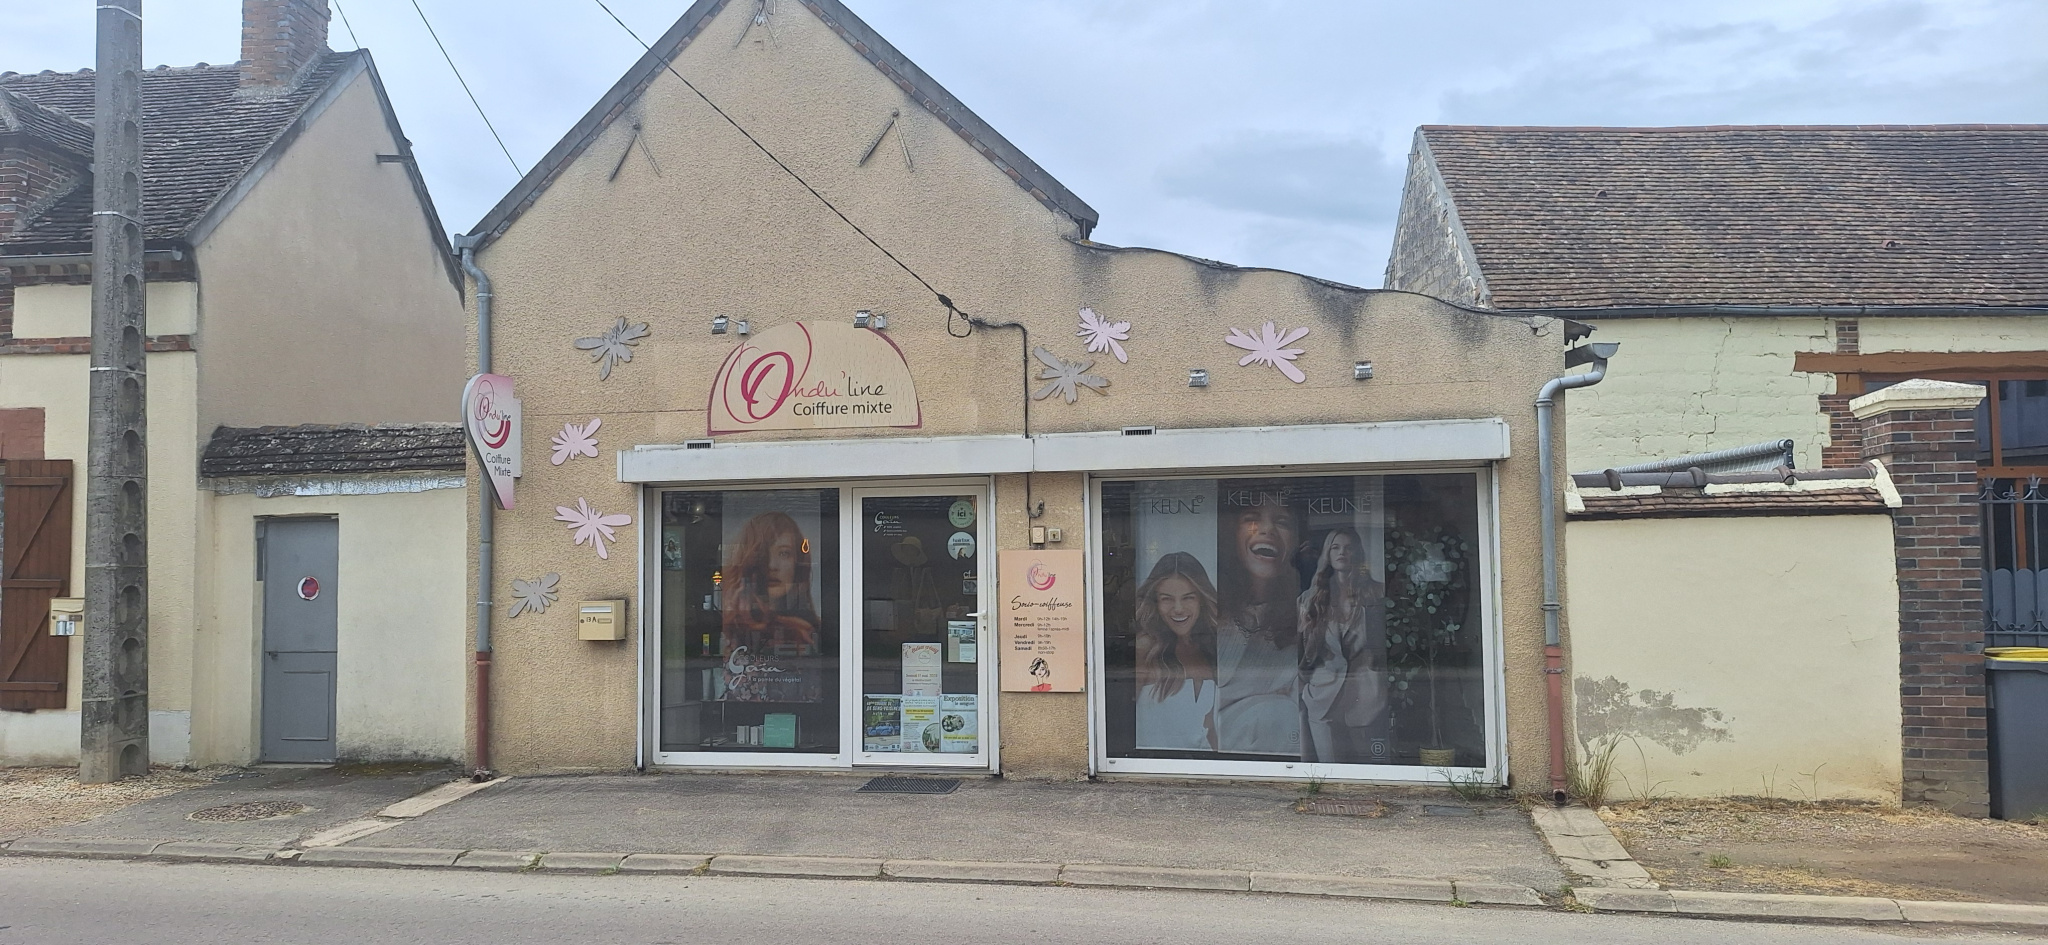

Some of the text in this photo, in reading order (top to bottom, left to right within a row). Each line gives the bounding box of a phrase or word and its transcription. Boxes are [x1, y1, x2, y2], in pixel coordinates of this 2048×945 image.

[793, 400, 892, 416] Coiffure mixte
[485, 452, 512, 465] Coiffure
[494, 465, 512, 477] Mixte
[1151, 498, 1200, 515] KEUNE
[1227, 490, 1289, 508] KEUNE
[1308, 497, 1371, 515] KEUNE
[957, 509, 966, 517] ici
[1011, 595, 1073, 611] Socio-coiffeuse
[728, 645, 787, 690] Gaïa
[943, 695, 975, 703] Exposition
